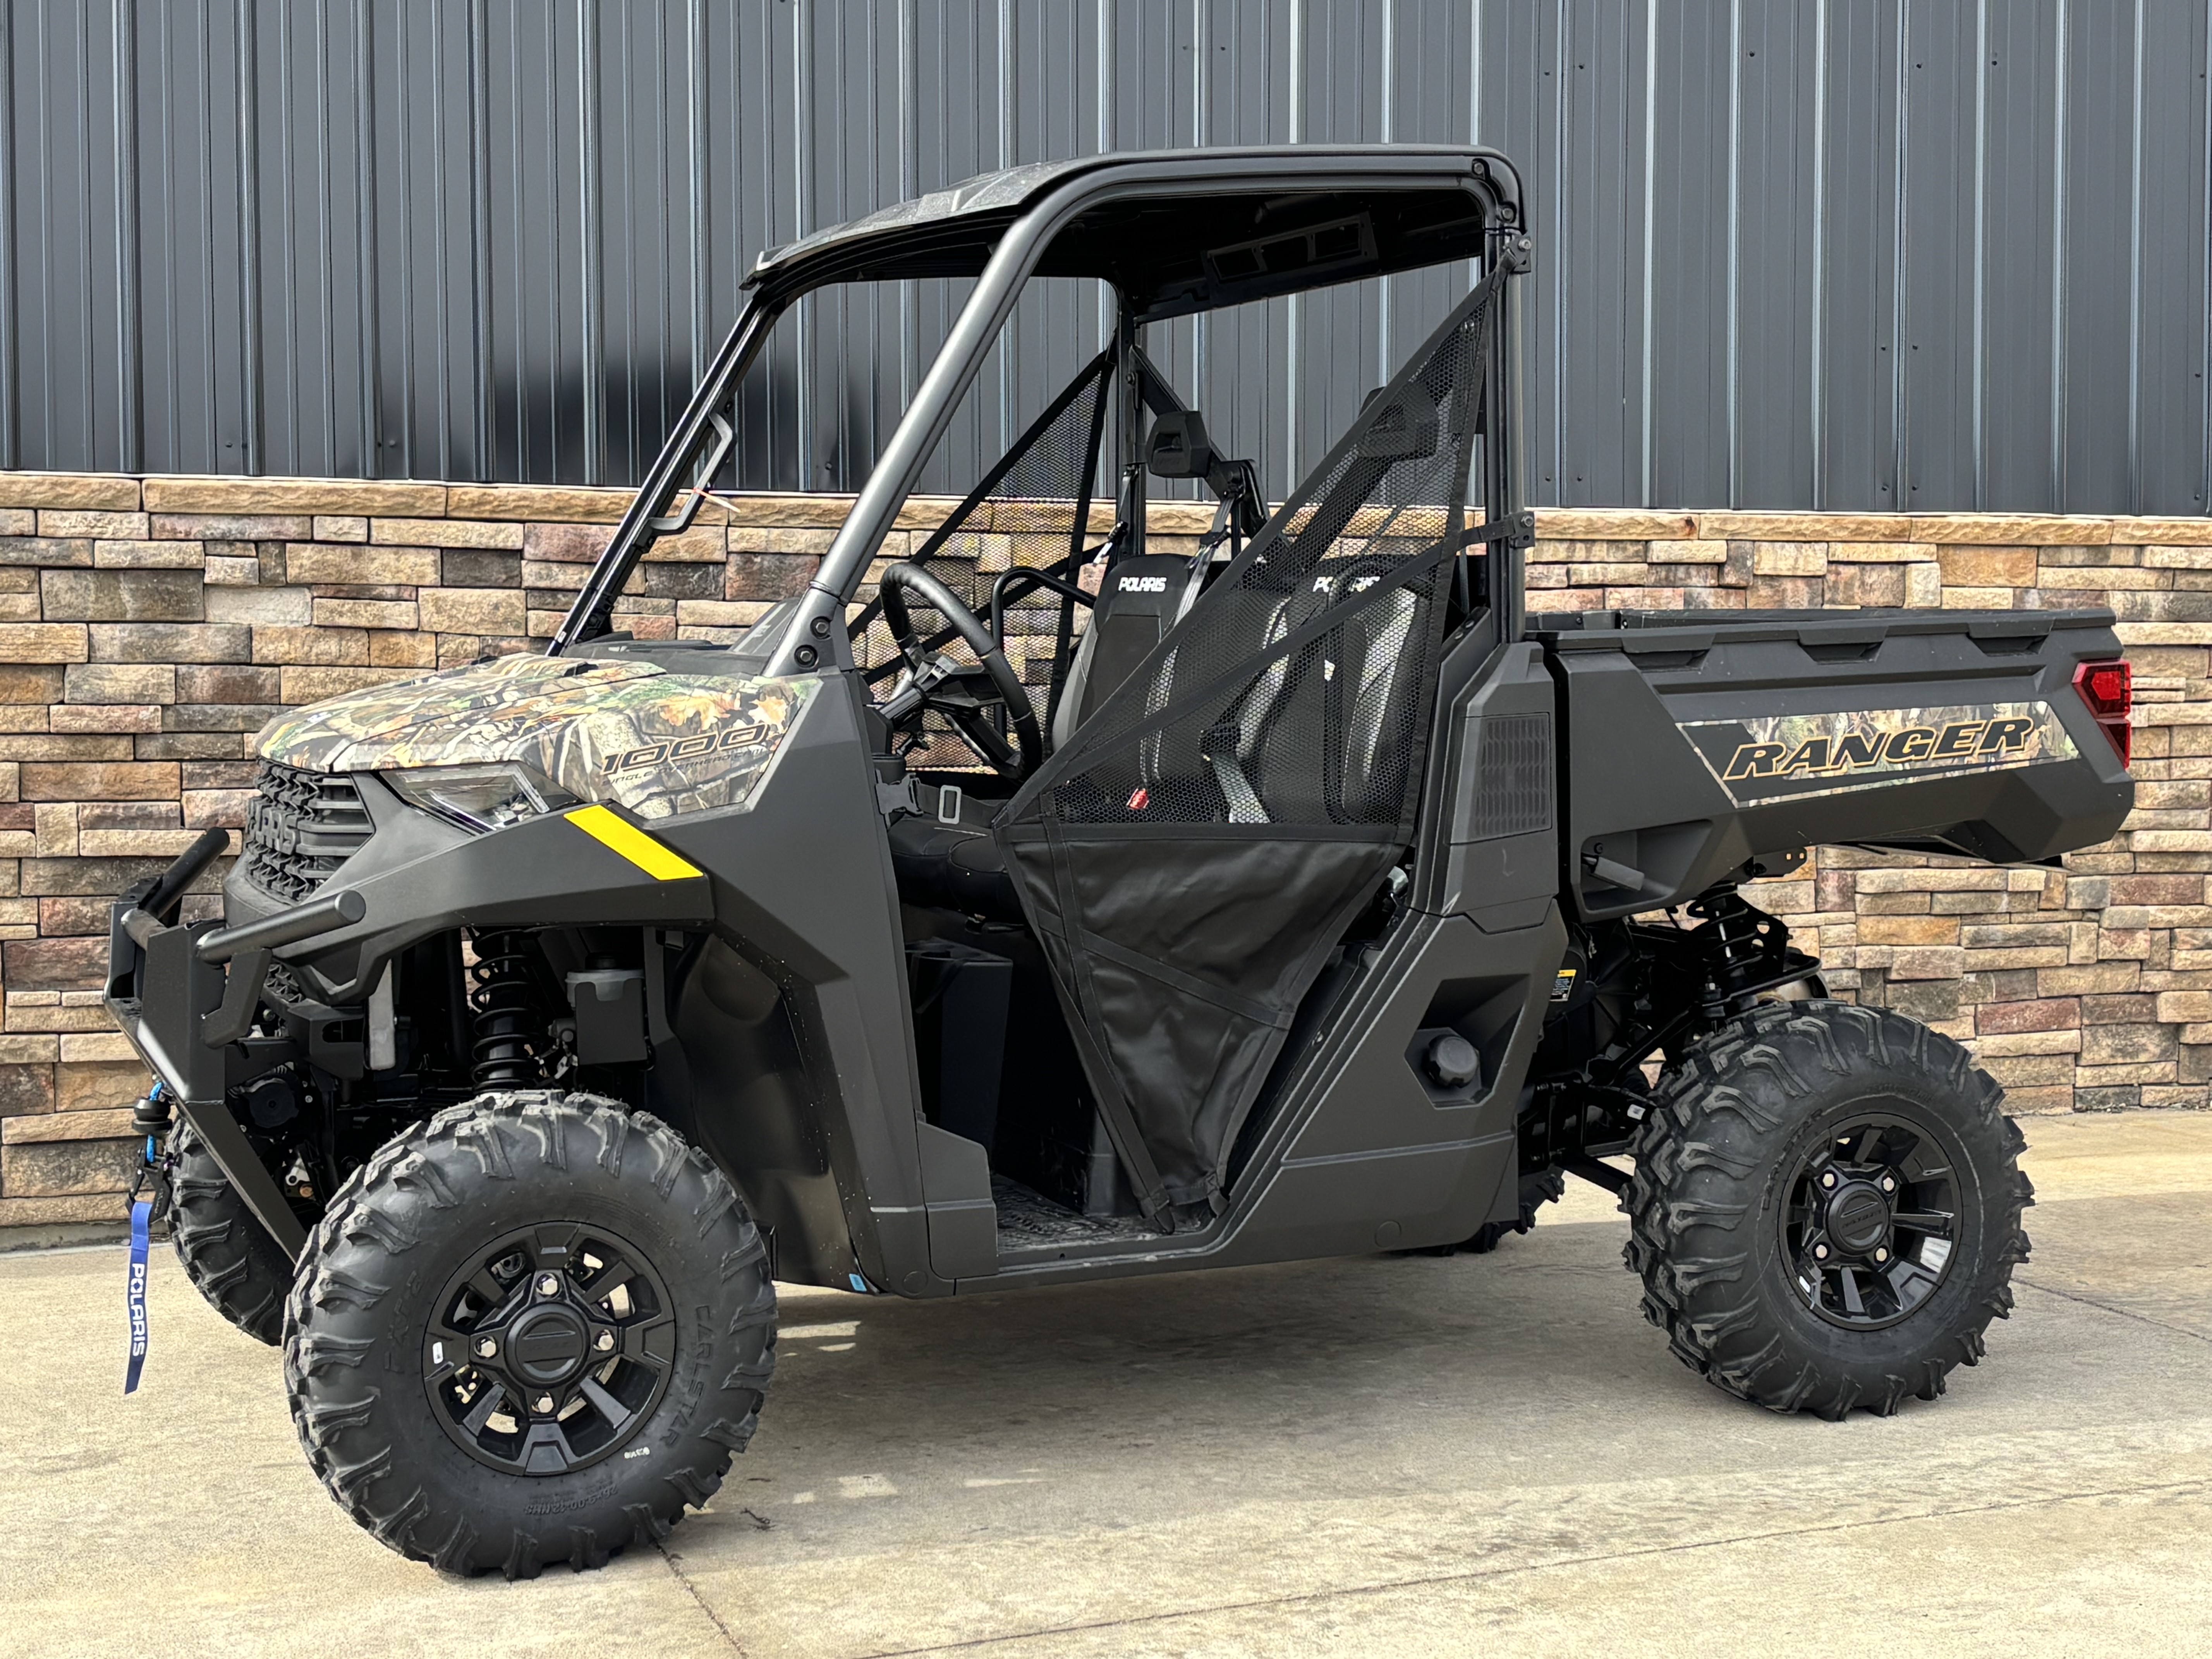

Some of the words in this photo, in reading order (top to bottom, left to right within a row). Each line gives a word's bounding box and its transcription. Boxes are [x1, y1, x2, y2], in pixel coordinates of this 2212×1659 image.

[1118, 576, 1167, 592] POLARIS
[599, 723, 770, 775] 1000
[1723, 717, 2034, 781] RANGER
[129, 1262, 145, 1358] POLARIS
[659, 1305, 716, 1448] CARLSTAR
